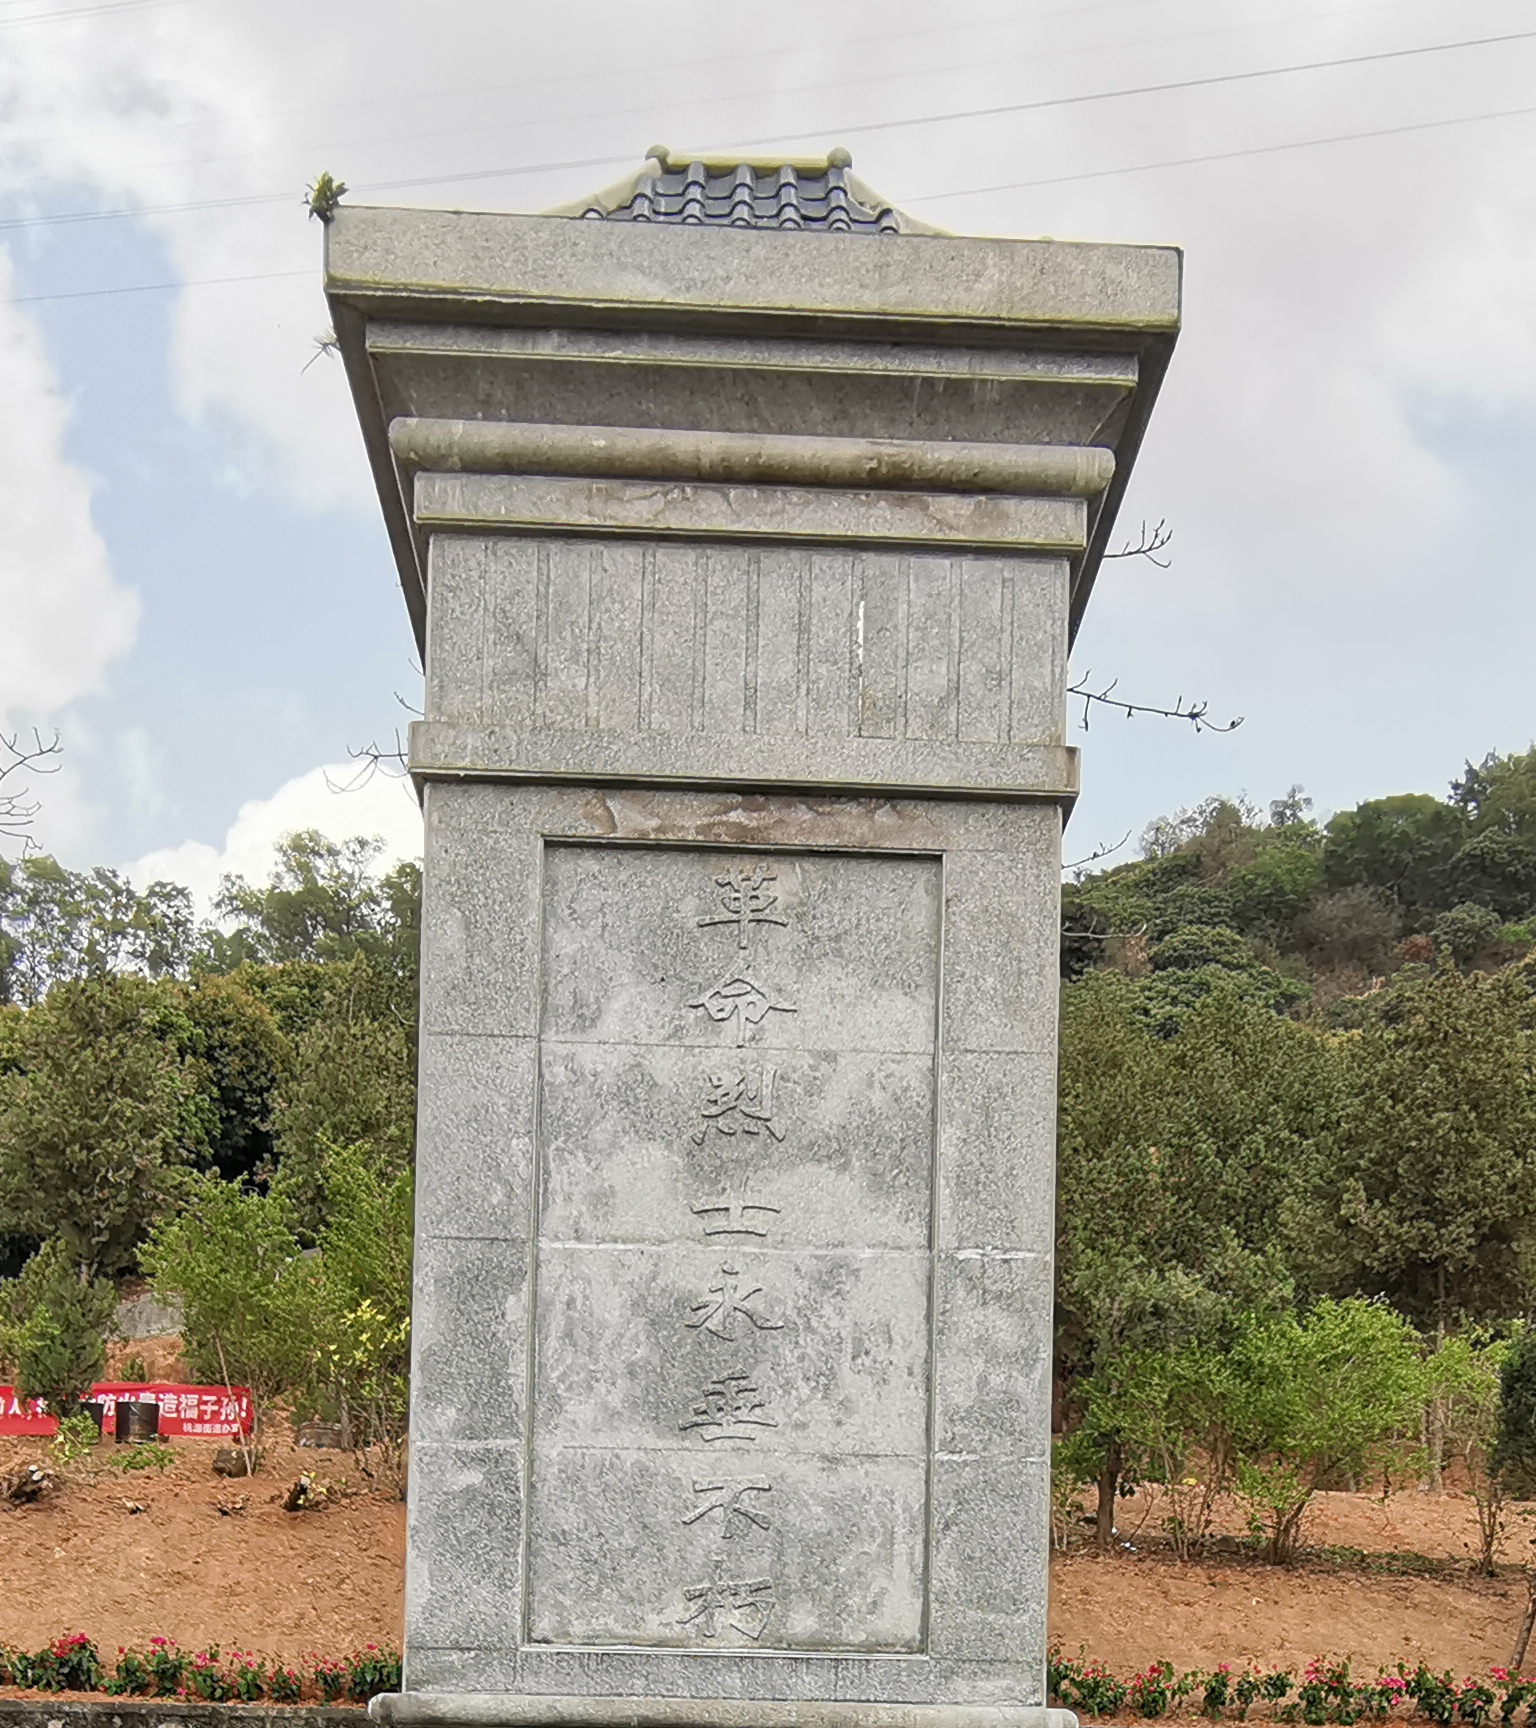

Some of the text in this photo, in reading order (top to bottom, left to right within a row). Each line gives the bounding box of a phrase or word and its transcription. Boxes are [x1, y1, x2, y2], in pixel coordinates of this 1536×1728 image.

[676, 865, 797, 1641] 革命烈士永垂不朽
